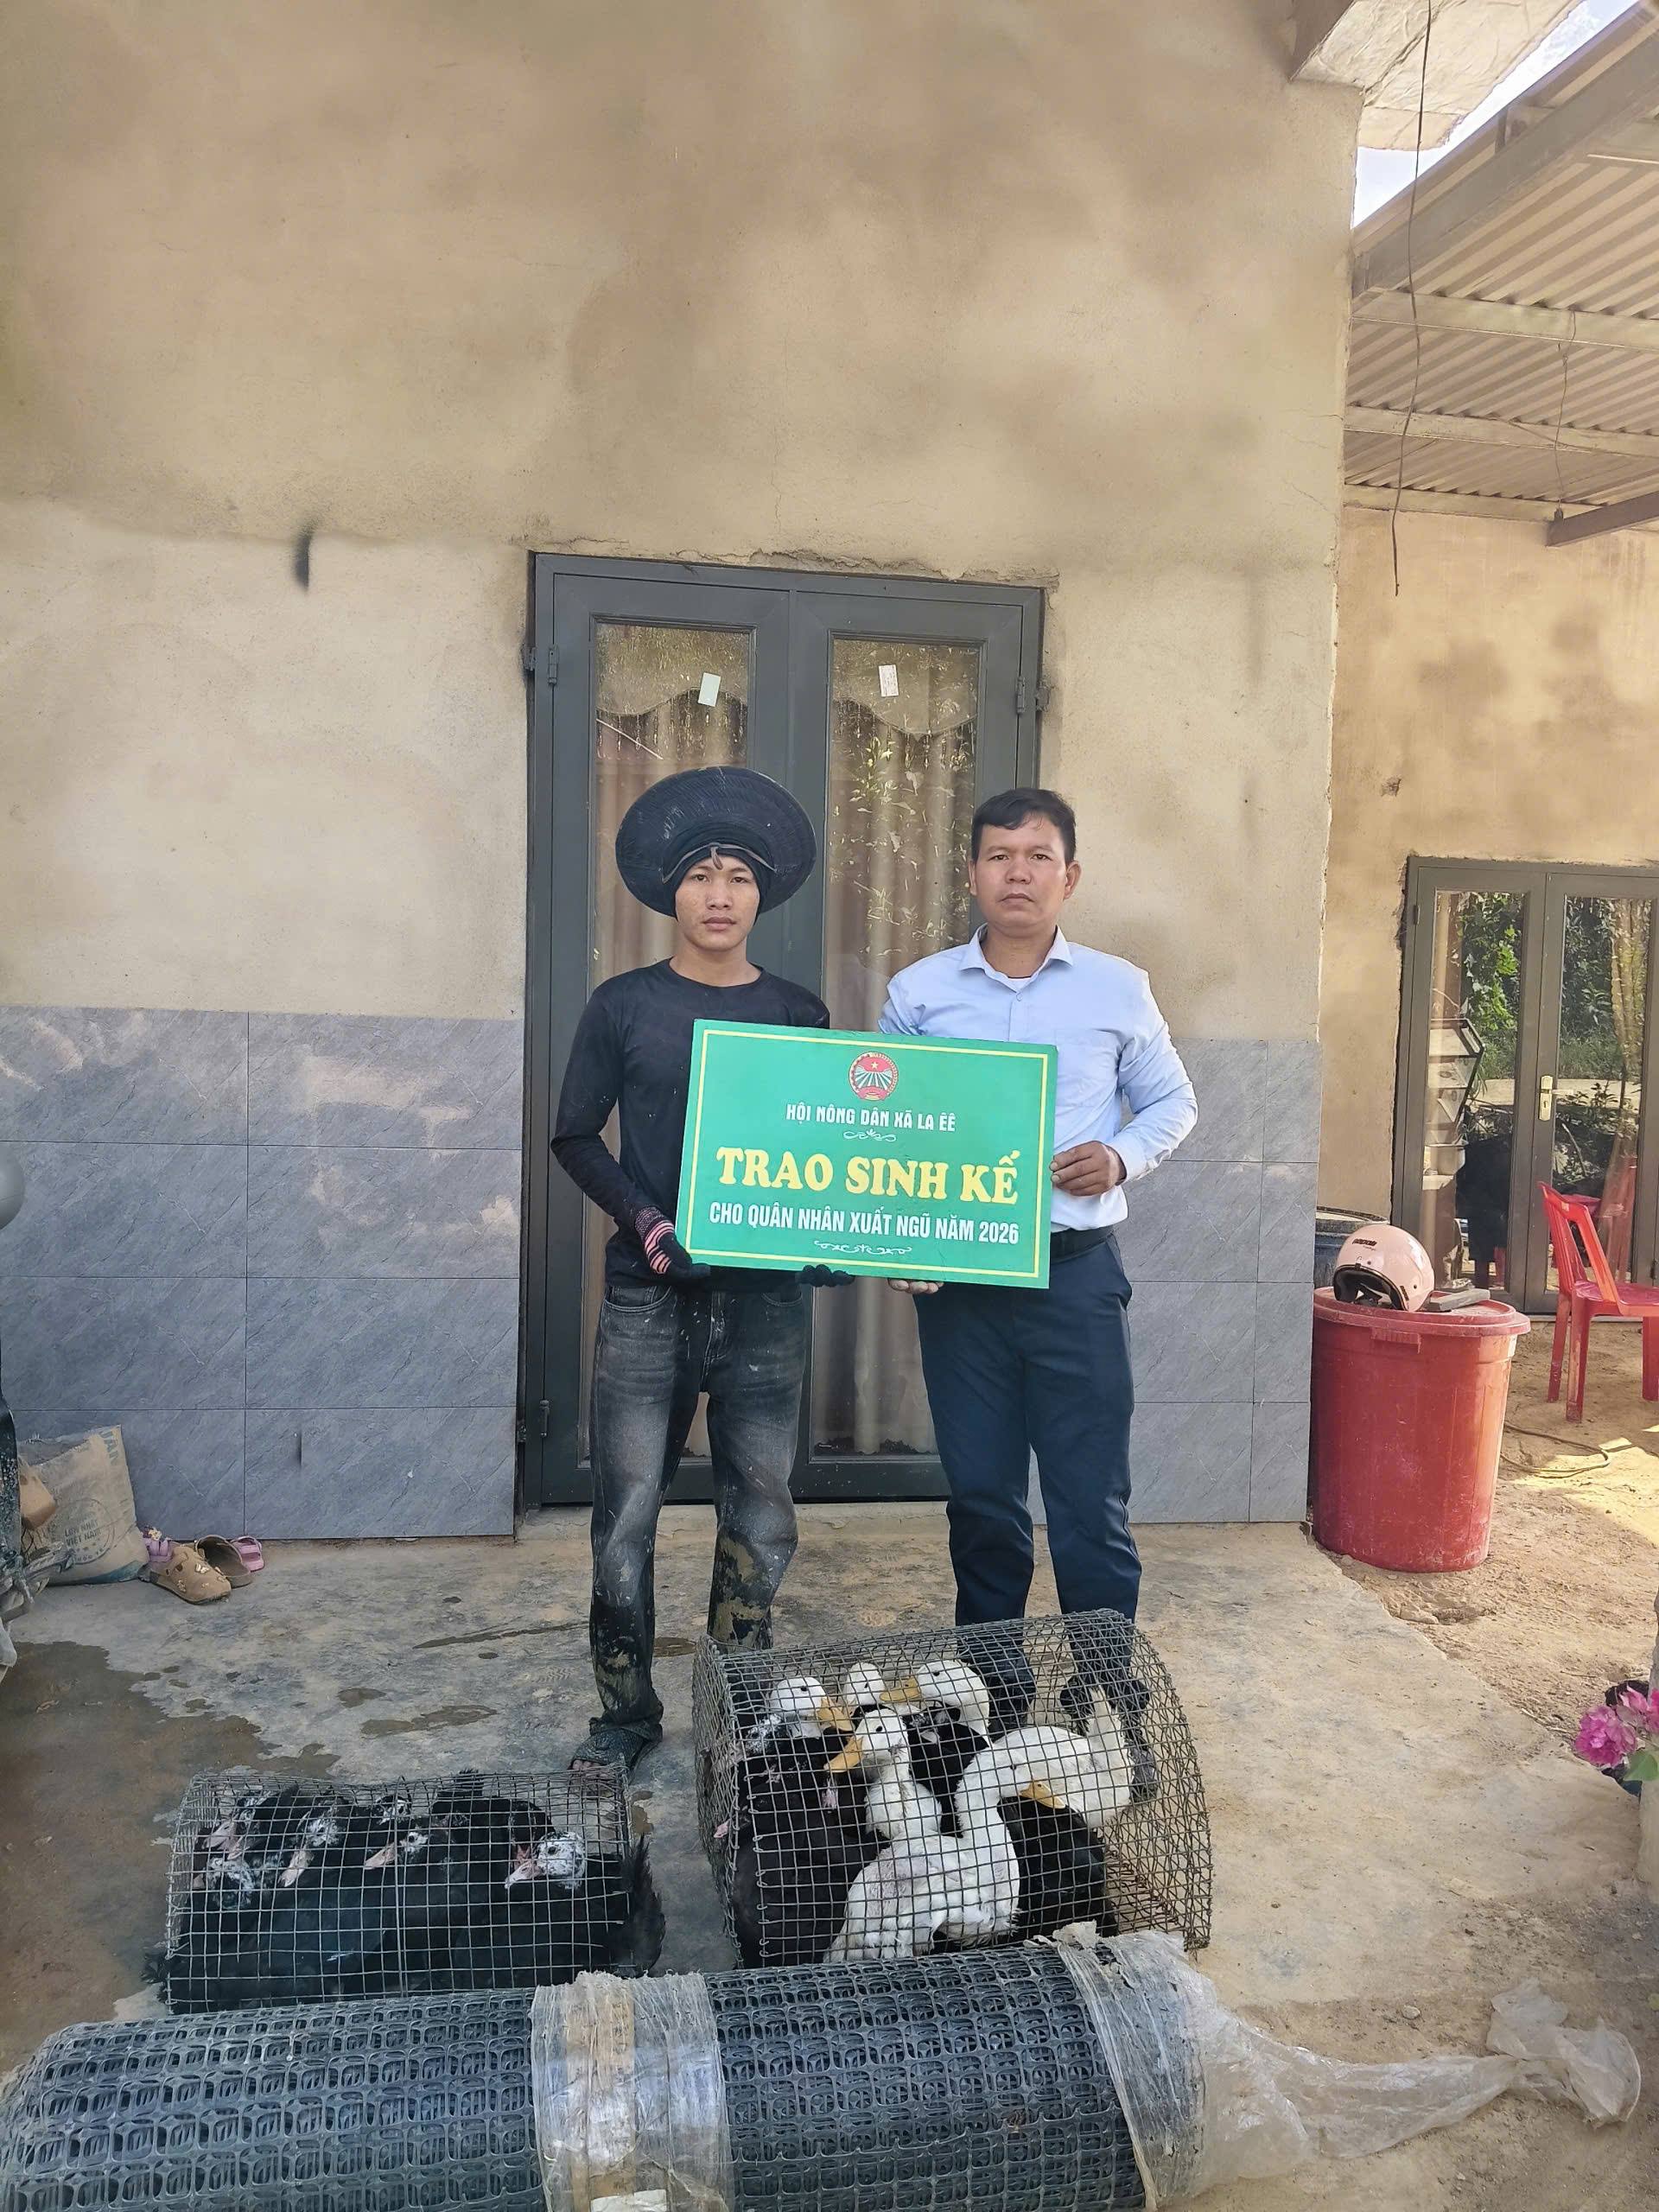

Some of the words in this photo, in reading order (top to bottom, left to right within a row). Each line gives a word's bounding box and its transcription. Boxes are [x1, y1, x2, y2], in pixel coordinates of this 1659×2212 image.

[786, 1102, 810, 1124] HỘI
[816, 1104, 855, 1124] NÔNG
[860, 1107, 890, 1128] DÂN
[893, 1109, 913, 1129] XÃ
[917, 1113, 934, 1131] LA
[938, 1112, 956, 1132] ÊÊ
[715, 1147, 834, 1192] TRAO
[845, 1156, 949, 1200] SINH
[959, 1149, 1020, 1205] KẾ
[709, 1202, 744, 1225] CHO
[747, 1202, 792, 1229] QUÂN
[798, 1205, 844, 1232] NHÂN
[849, 1206, 893, 1236] XUẤT
[896, 1212, 931, 1238] NGŨ
[935, 1214, 974, 1242] NĂM
[978, 1221, 1020, 1244] 2026
